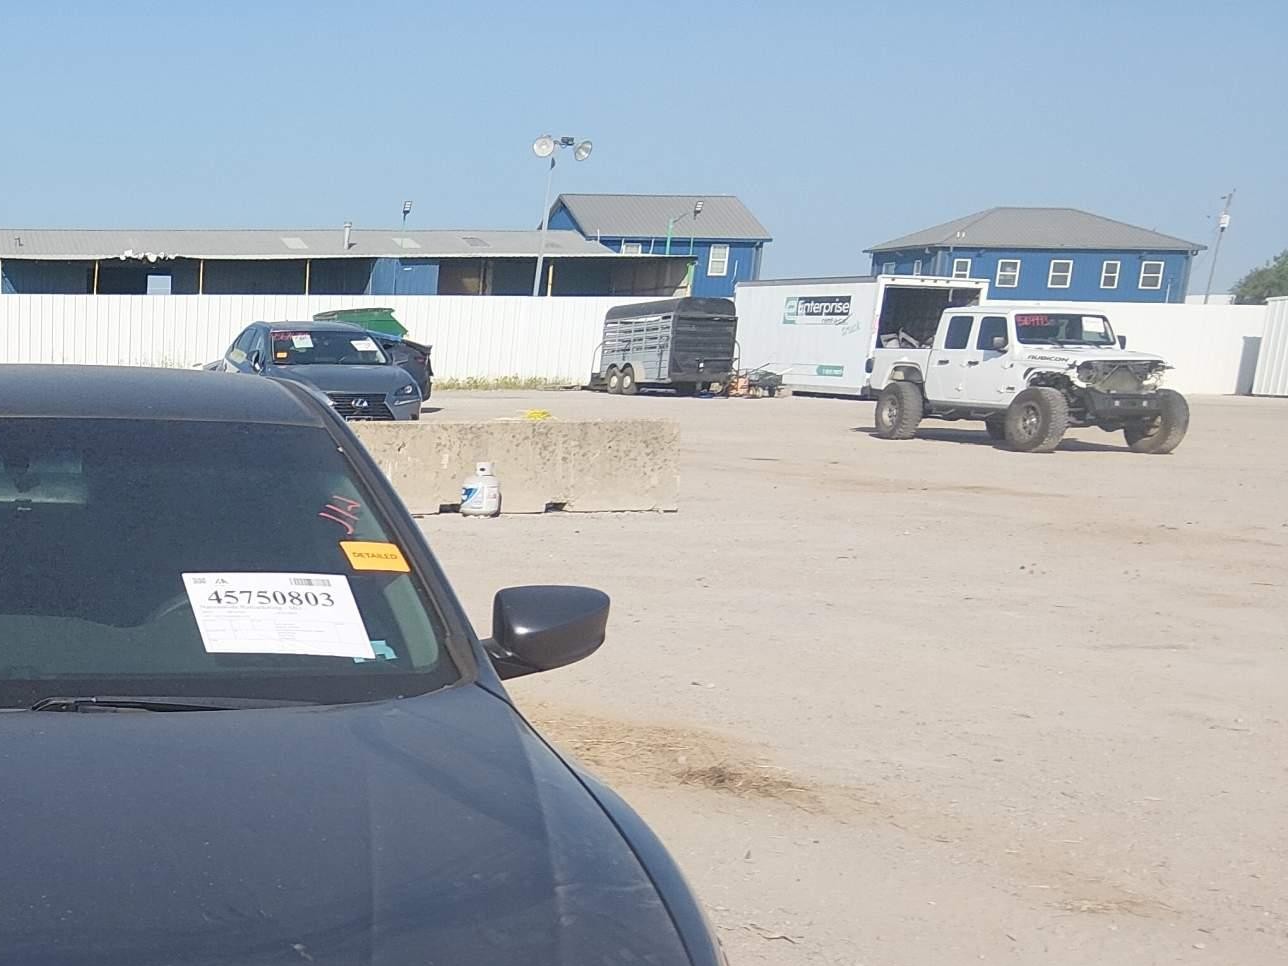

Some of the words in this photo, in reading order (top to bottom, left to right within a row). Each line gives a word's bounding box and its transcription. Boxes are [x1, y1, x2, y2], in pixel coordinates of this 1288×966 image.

[798, 298, 850, 316] Enterprise
[1027, 354, 1070, 363] RUBICON
[351, 551, 399, 560] DETAILED
[207, 589, 336, 607] 45750803
